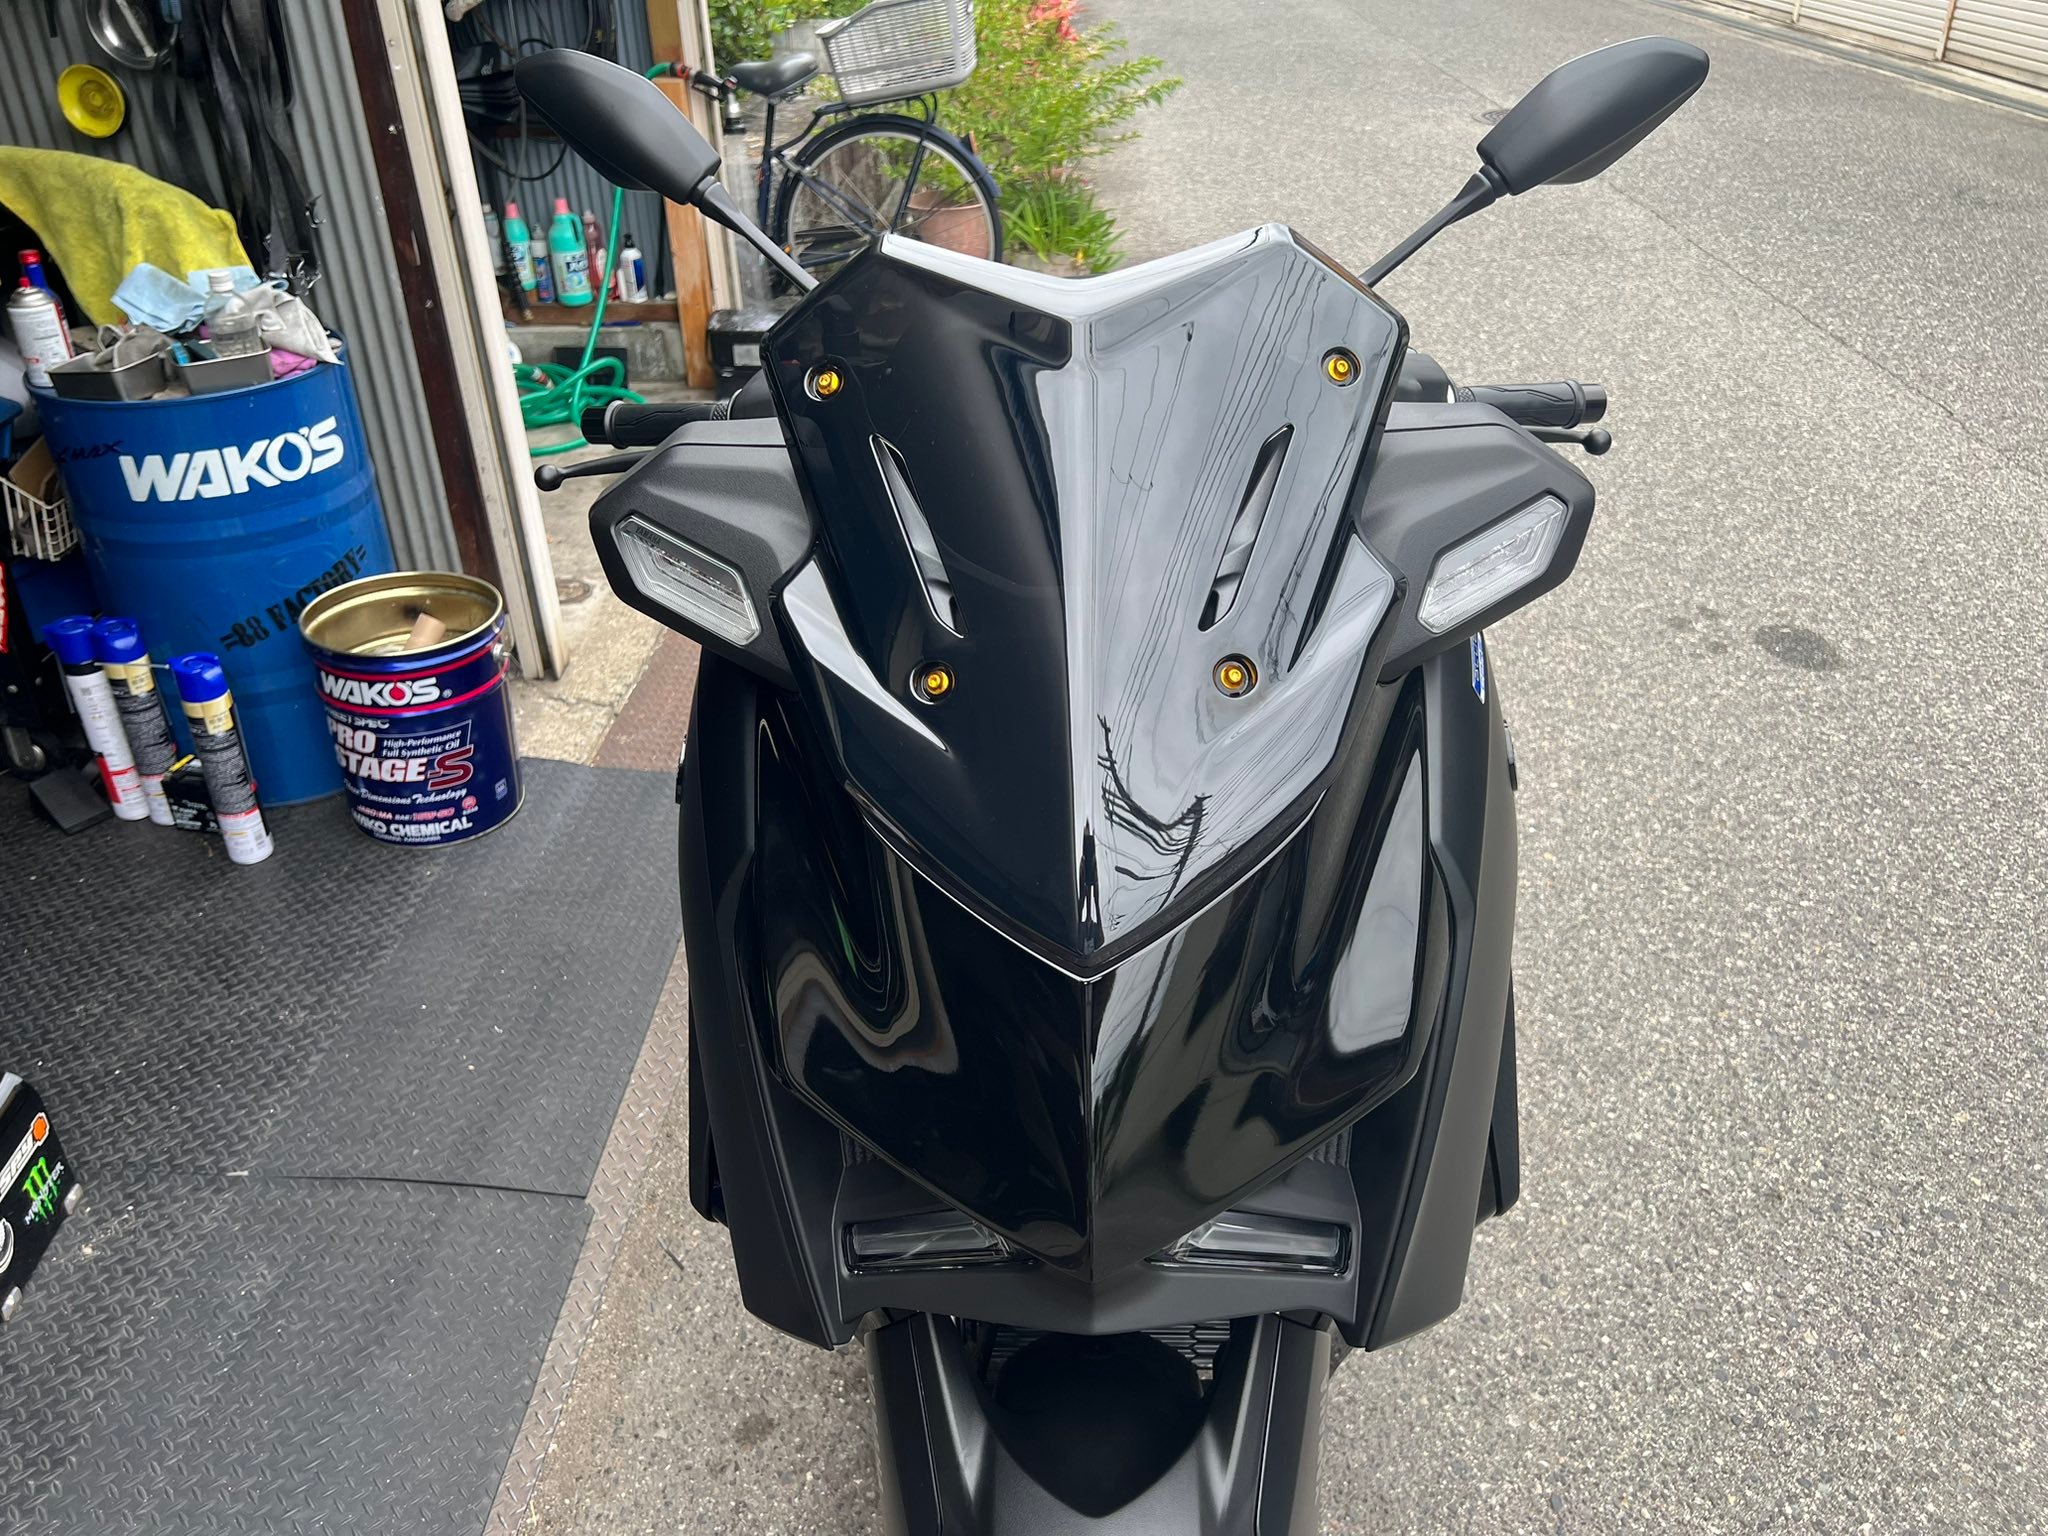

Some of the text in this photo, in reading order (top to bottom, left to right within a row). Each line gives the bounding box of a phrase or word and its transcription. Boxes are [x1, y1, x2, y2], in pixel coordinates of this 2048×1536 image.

[118, 415, 345, 502] WAKO'S
[320, 670, 440, 707] WAKO'S
[326, 714, 376, 754] PRO
[382, 738, 460, 759] Full Synthetic Oil
[383, 730, 462, 749] High-Performance
[334, 743, 428, 782] STAGE
[412, 788, 467, 804] Technology
[390, 815, 473, 838] CHEMICAL
